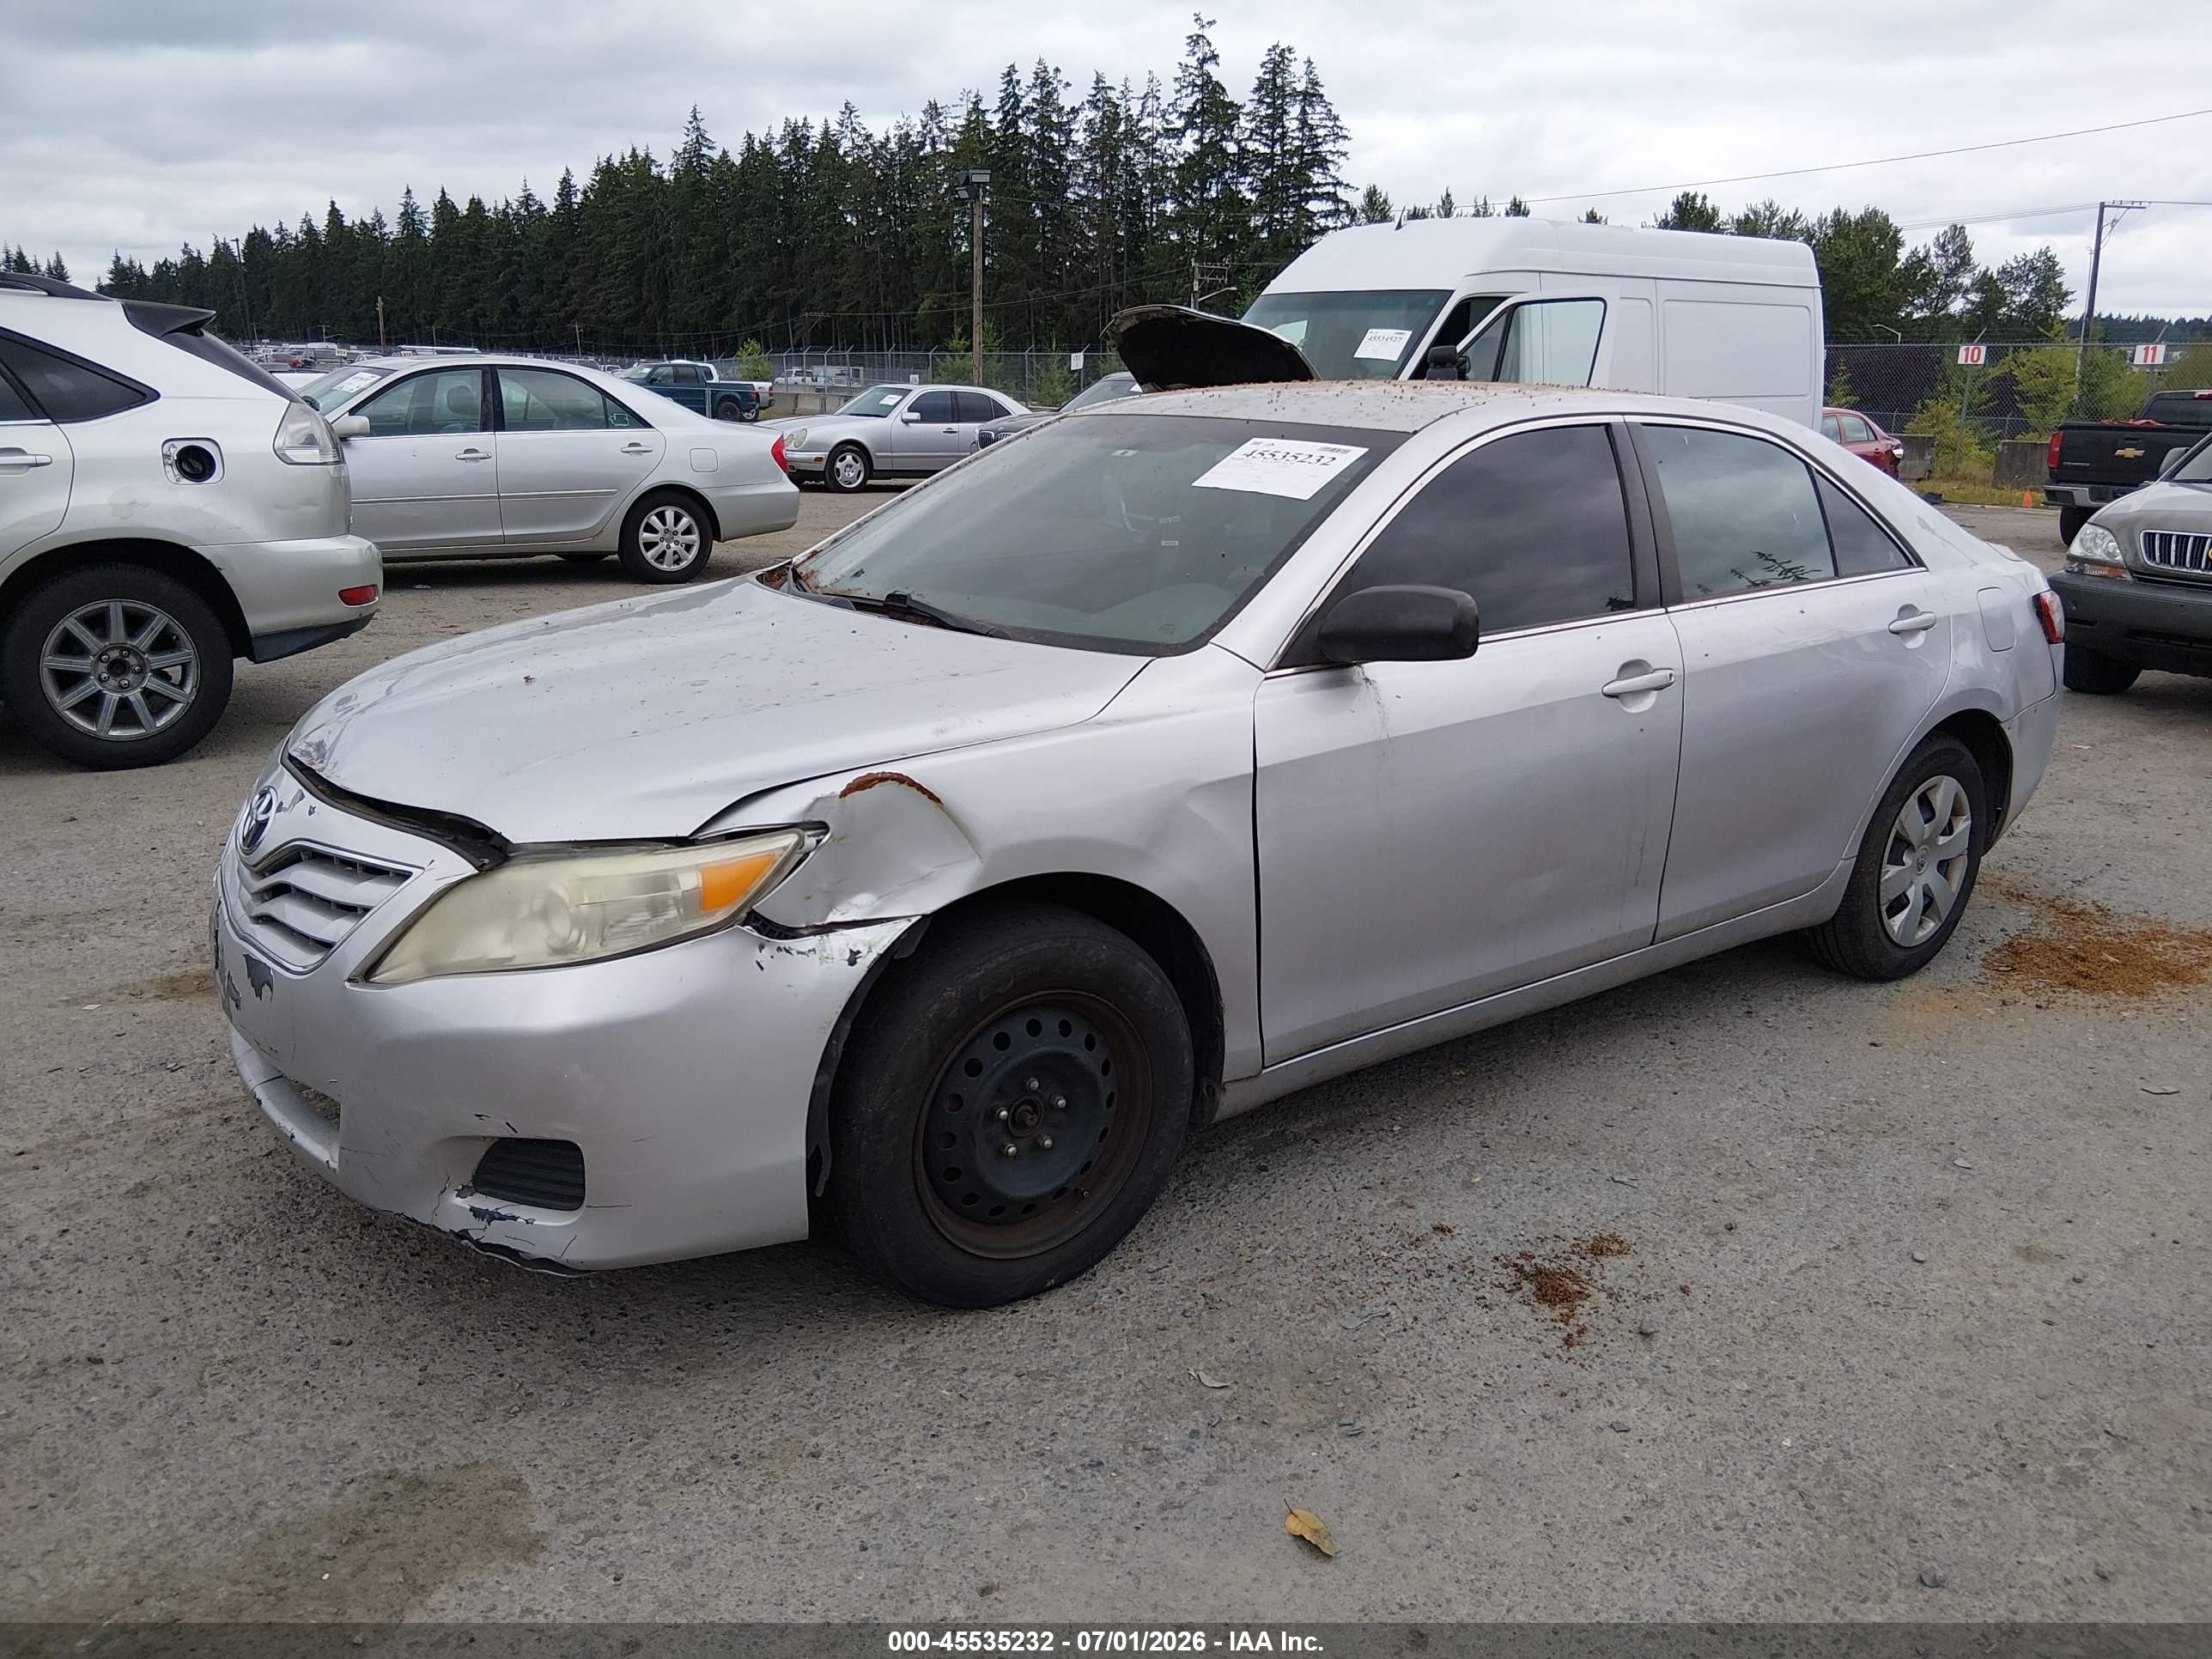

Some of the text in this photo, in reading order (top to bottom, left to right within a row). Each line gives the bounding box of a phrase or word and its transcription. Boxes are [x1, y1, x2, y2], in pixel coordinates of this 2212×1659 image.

[1964, 346, 1982, 363] 10
[2142, 345, 2158, 363] 11
[1243, 449, 1337, 466] 45535232
